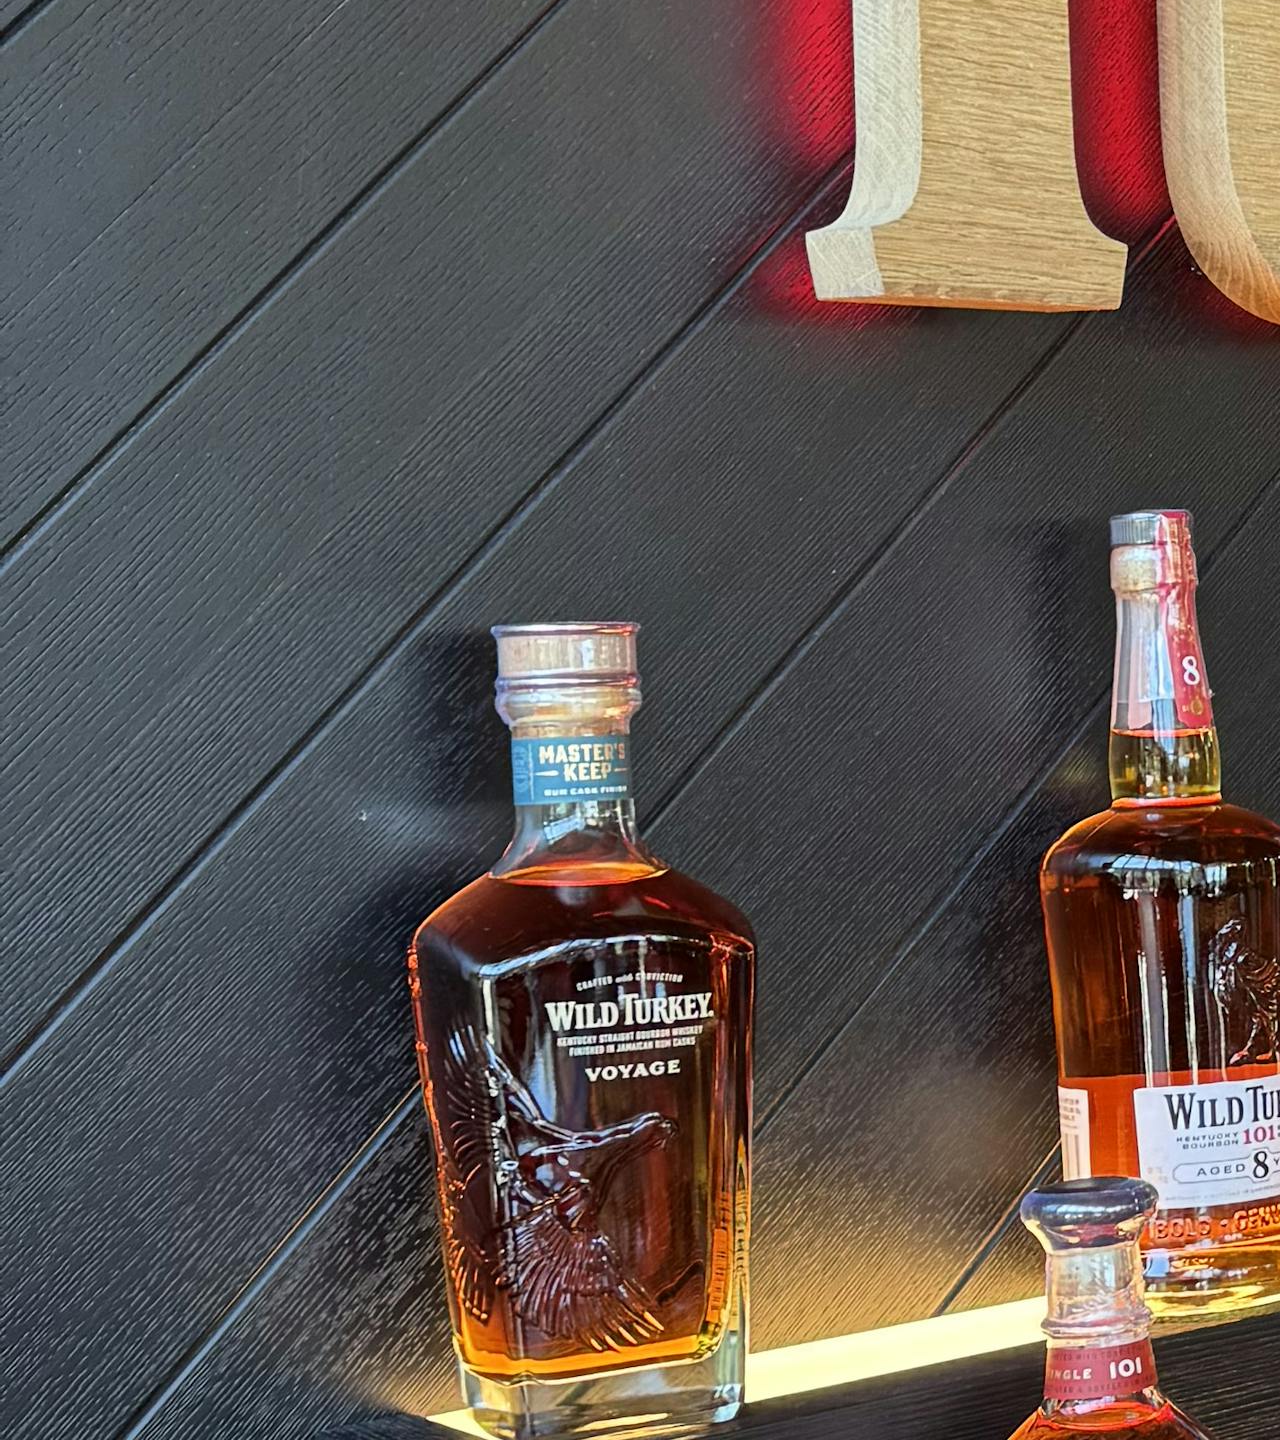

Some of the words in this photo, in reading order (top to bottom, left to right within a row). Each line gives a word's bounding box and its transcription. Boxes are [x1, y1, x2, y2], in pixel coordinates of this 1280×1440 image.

[1182, 655, 1200, 685] 8
[539, 743, 625, 764] MASTER'S
[563, 762, 612, 782] KEEP
[570, 786, 599, 795] CASK
[576, 975, 613, 991] CRAFTED
[635, 972, 684, 983] CONVICTION
[544, 1001, 620, 1032] WILD
[556, 1035, 597, 1048] KENTUCKY
[598, 1031, 635, 1044] STRAIGHT
[636, 1028, 671, 1041] BOURBON
[672, 1025, 704, 1037] WHISKEY
[569, 1045, 605, 1057] FINISHED
[606, 1044, 615, 1053] IN
[617, 1040, 654, 1053] JAMAICAN
[655, 1038, 672, 1048] RUM
[673, 1036, 696, 1047] CASKS
[585, 1059, 681, 1082] VOYAGE
[1164, 1092, 1244, 1130] WILD
[1176, 1131, 1239, 1142] KENTUCKY
[1243, 1124, 1276, 1145] 101
[1182, 1139, 1239, 1150] BOURBON
[1197, 1163, 1246, 1177] AGED
[1252, 1150, 1270, 1179] 8
[1109, 1357, 1142, 1380] 101
